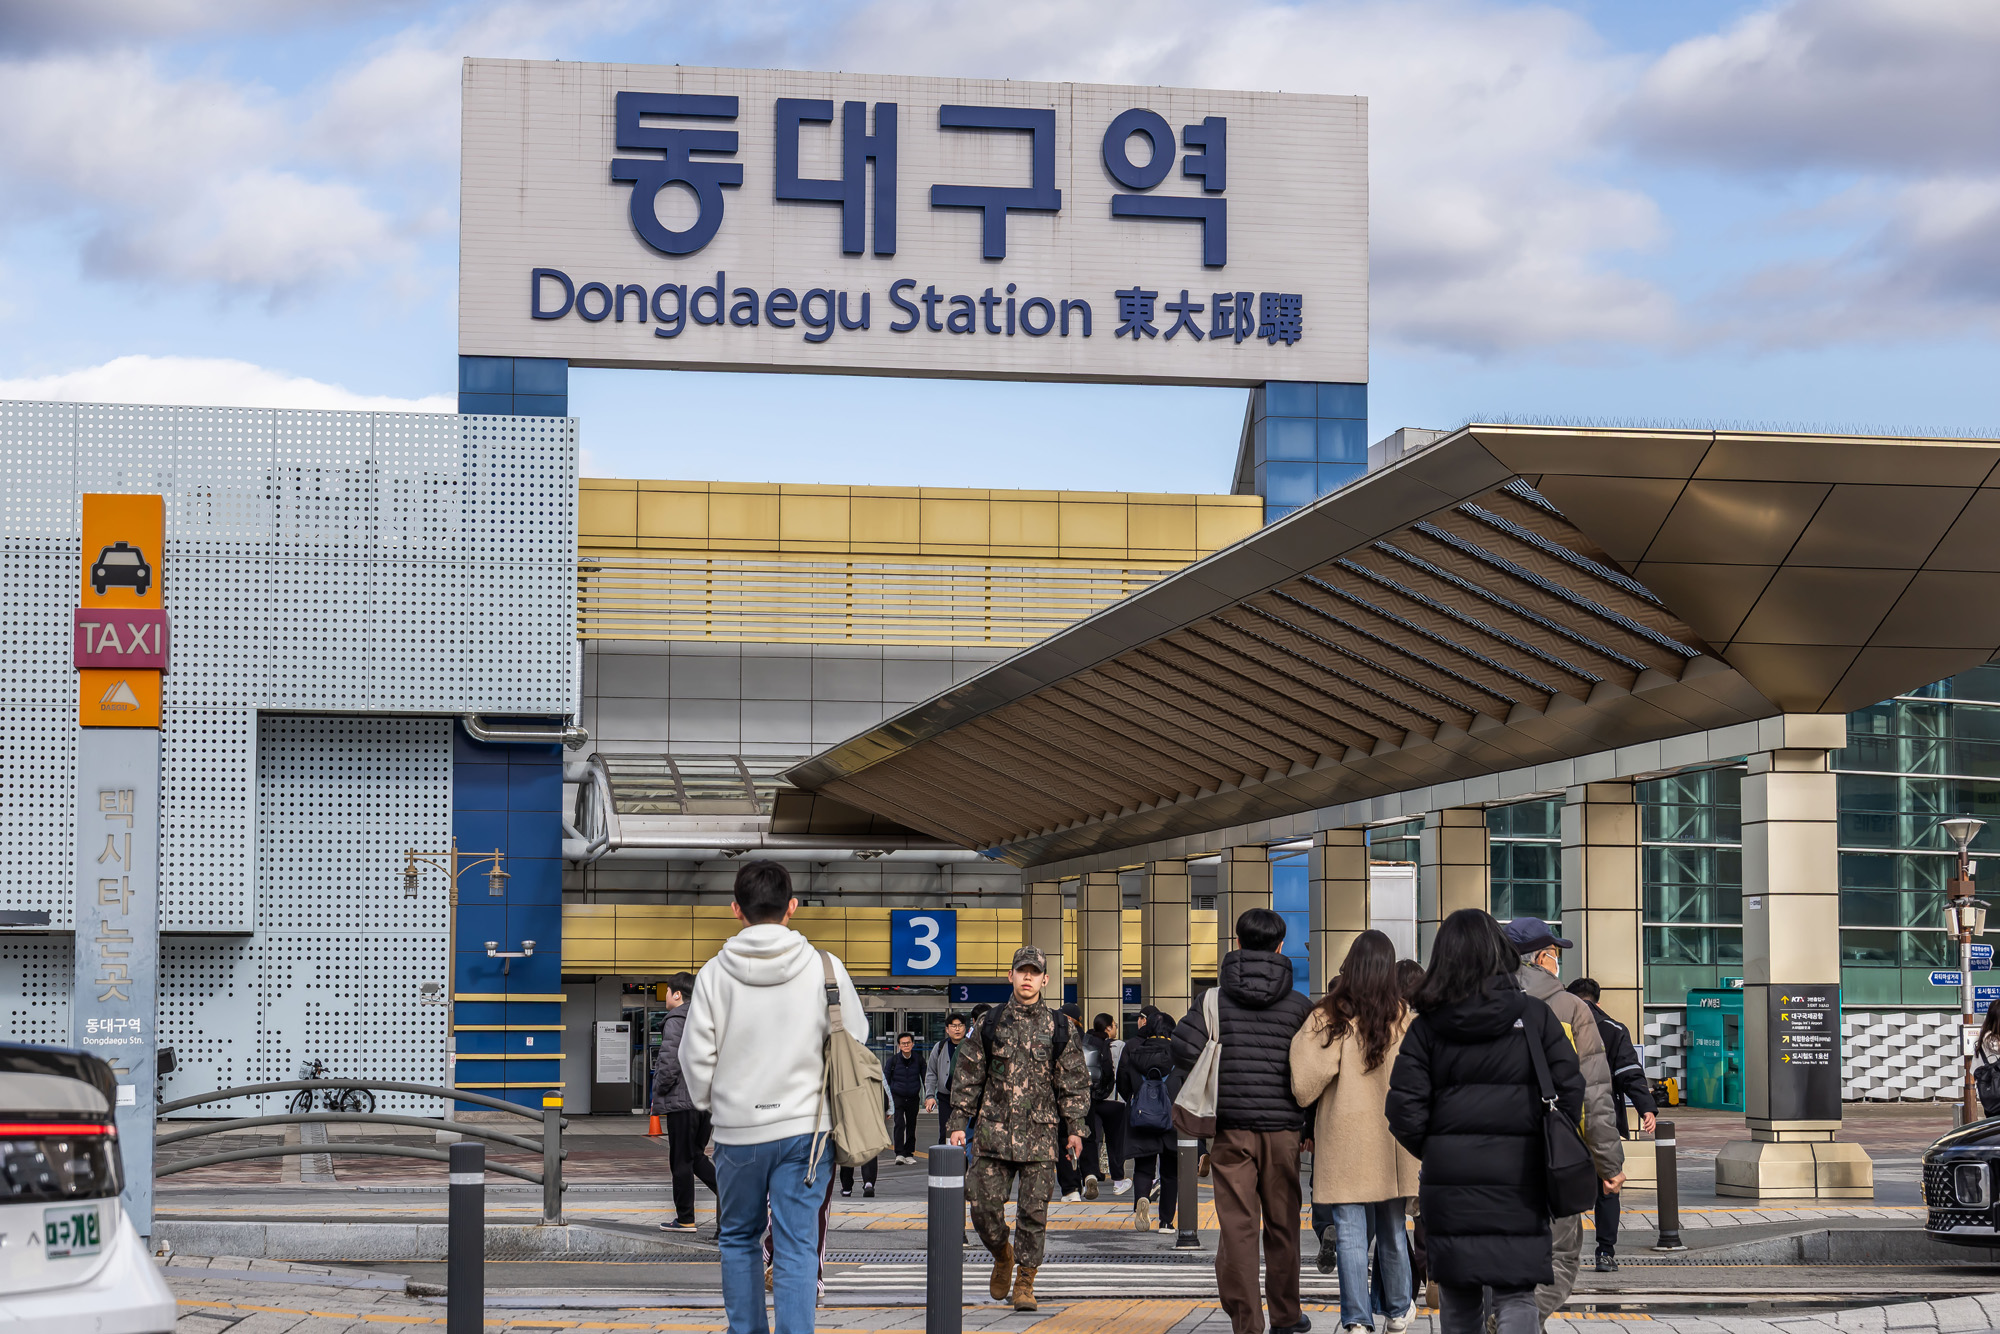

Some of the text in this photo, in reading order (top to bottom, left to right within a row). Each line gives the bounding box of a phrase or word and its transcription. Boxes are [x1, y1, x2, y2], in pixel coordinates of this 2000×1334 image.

[612, 91, 1227, 268] 동대구역
[531, 267, 1303, 345] Dongdaegu Station 東大邱驛
[79, 622, 161, 655] TAXI
[100, 703, 128, 711] DAEGU
[907, 916, 942, 971] 3
[960, 985, 969, 1001] 3
[1791, 1012, 1824, 1020] 대구국제공항
[85, 1018, 141, 1034] 동대구역
[83, 1036, 145, 1046] Dongdaegu Stn.
[1792, 1052, 1829, 1060] 도시철도 1호선
